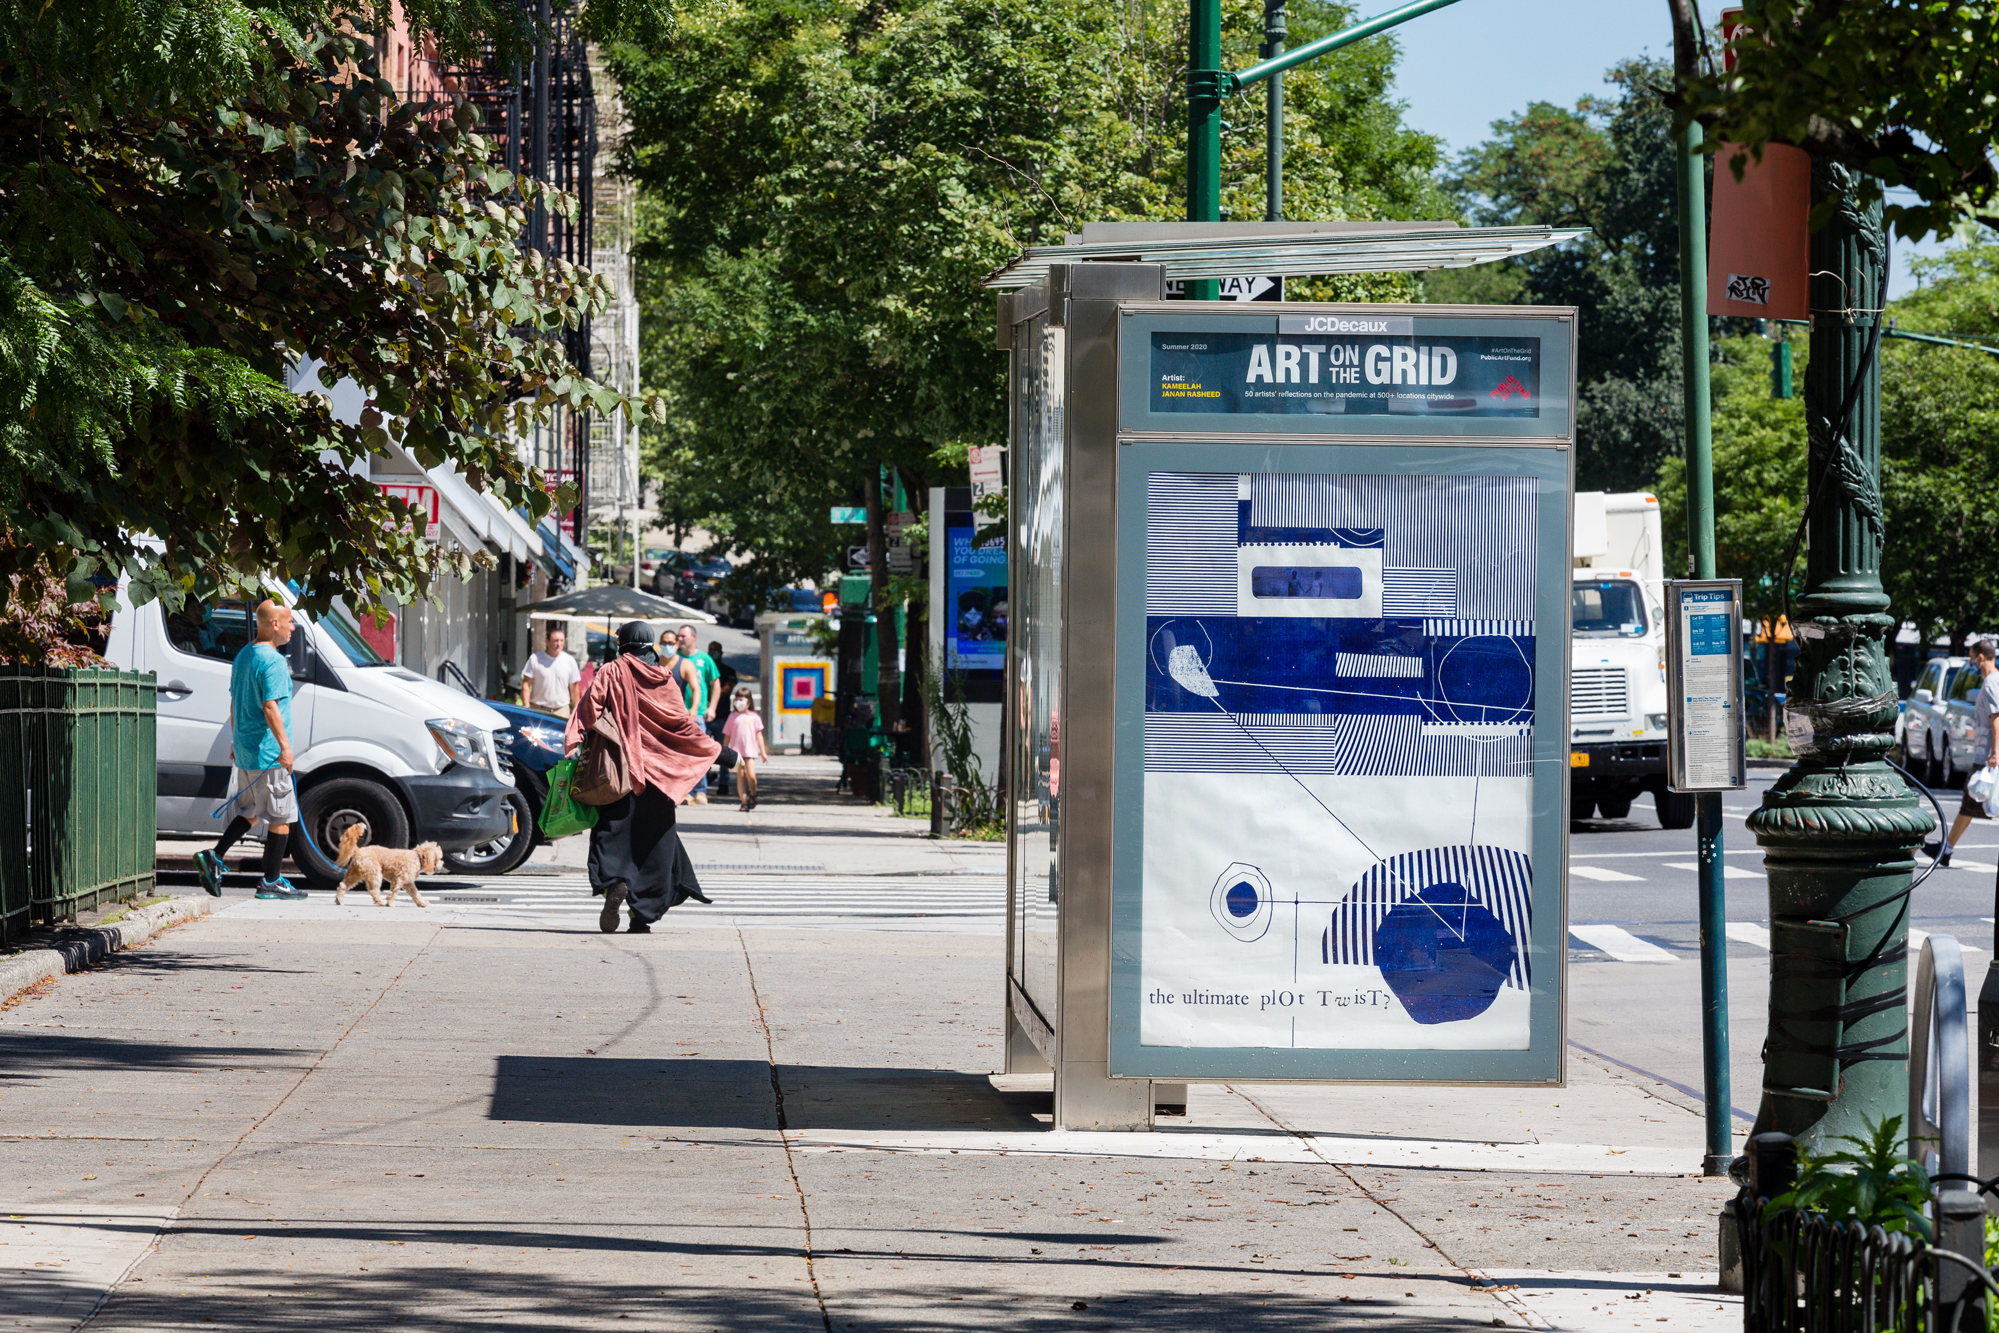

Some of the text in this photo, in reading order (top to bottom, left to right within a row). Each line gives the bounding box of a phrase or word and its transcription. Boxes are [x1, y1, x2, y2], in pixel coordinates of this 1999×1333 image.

[1166, 280, 1185, 292] NE
[1304, 317, 1388, 333] JCDecaux
[1245, 344, 1458, 386] ART ON THE GRID
[1480, 354, 1532, 362] PublicArtFund.org
[1161, 373, 1186, 382] Artist:
[1490, 374, 1516, 400] PUBLIC
[1500, 384, 1516, 401] ART
[1513, 380, 1532, 400] FUND
[1244, 390, 1254, 398] 50
[1335, 391, 1369, 400] pandemic
[1377, 391, 1395, 399] 500+
[1396, 391, 1426, 399] locations
[1426, 392, 1455, 401] citywide
[974, 482, 983, 496] 2
[380, 487, 434, 522] TM
[977, 547, 1008, 556] DREA
[953, 555, 968, 565] OF
[1693, 592, 1725, 601] Trip Tips
[1149, 988, 1175, 1005] the
[1182, 988, 1249, 1006] ultimate
